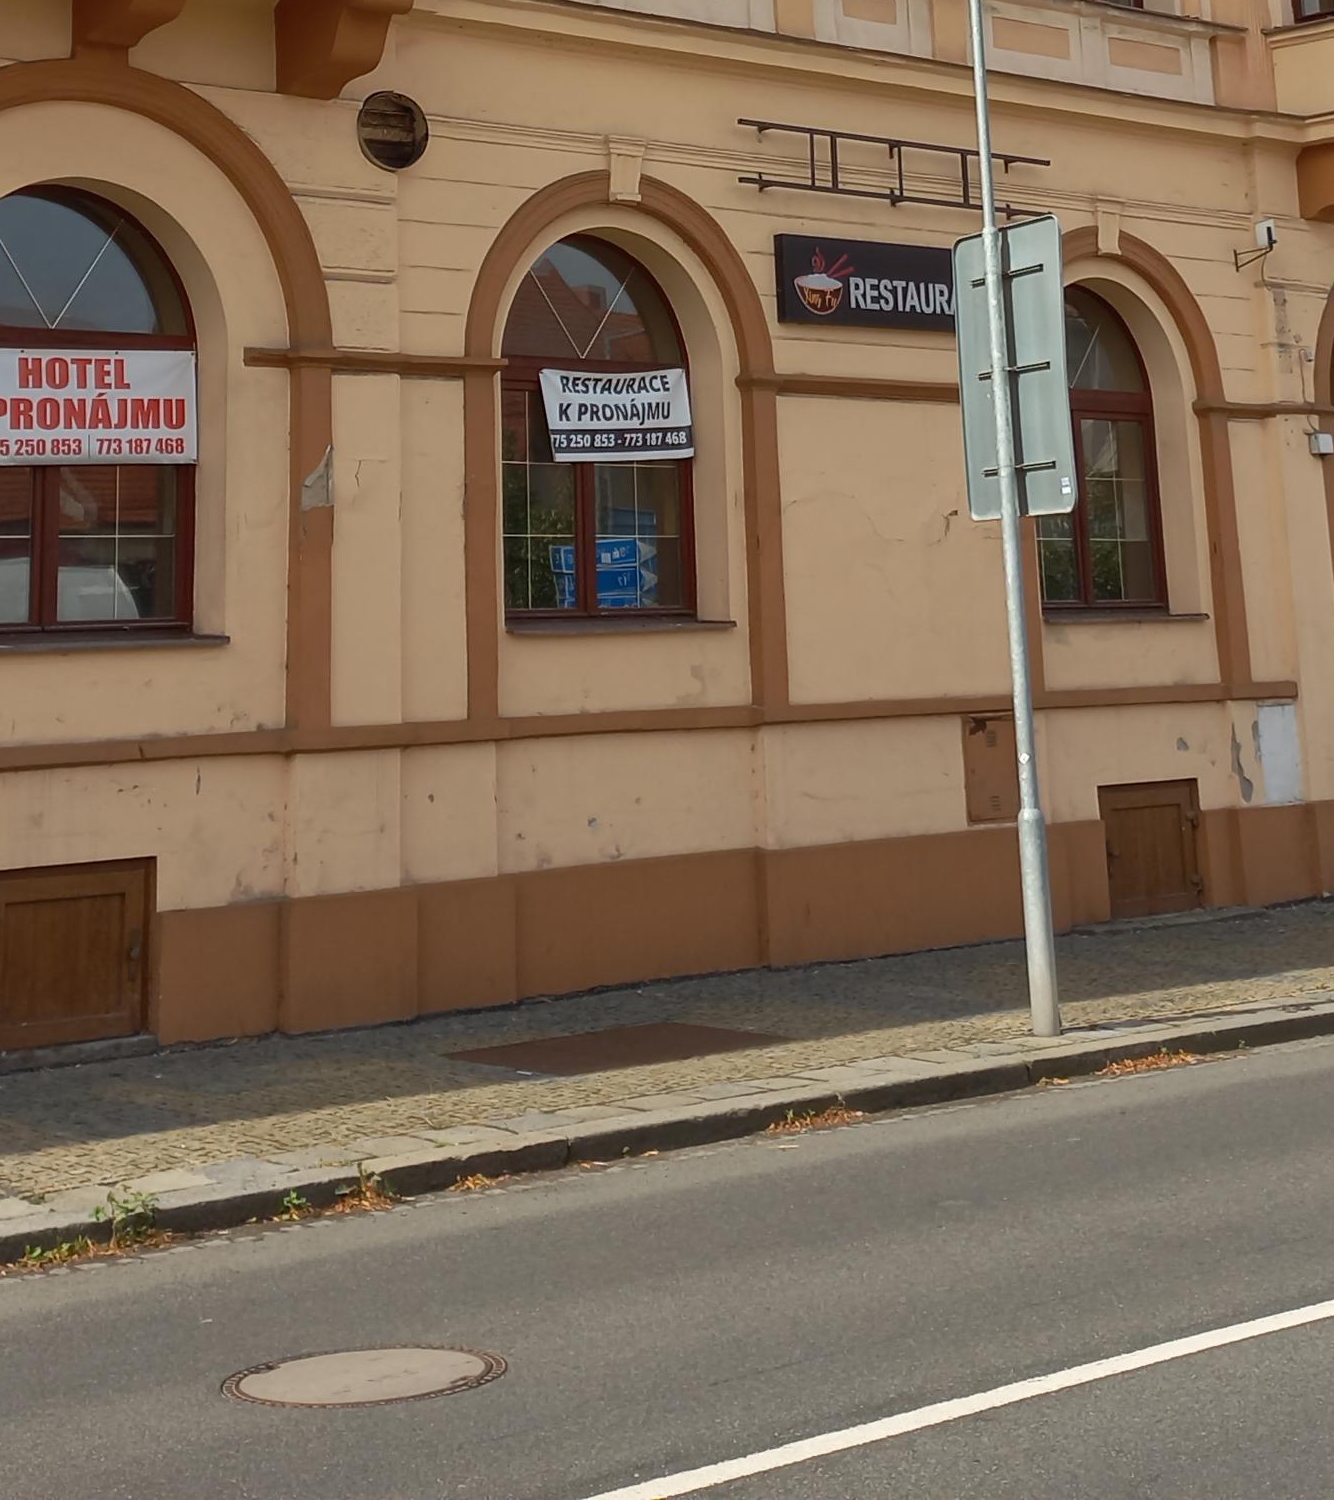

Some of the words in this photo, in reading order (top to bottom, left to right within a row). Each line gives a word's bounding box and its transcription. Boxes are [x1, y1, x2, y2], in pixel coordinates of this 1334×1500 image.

[18, 357, 131, 390] HOTEL
[560, 375, 670, 395] RESTAURACE
[558, 403, 572, 422] K
[577, 398, 671, 426] PRONÁJMU
[14, 439, 46, 456] 250
[51, 438, 82, 456] 853
[96, 438, 122, 455] 773
[125, 438, 152, 455] 187
[155, 438, 185, 455] 468
[569, 434, 591, 448] 250
[593, 433, 615, 448] 853
[624, 433, 643, 447] 773
[646, 432, 662, 446] 187
[665, 431, 687, 445] 468
